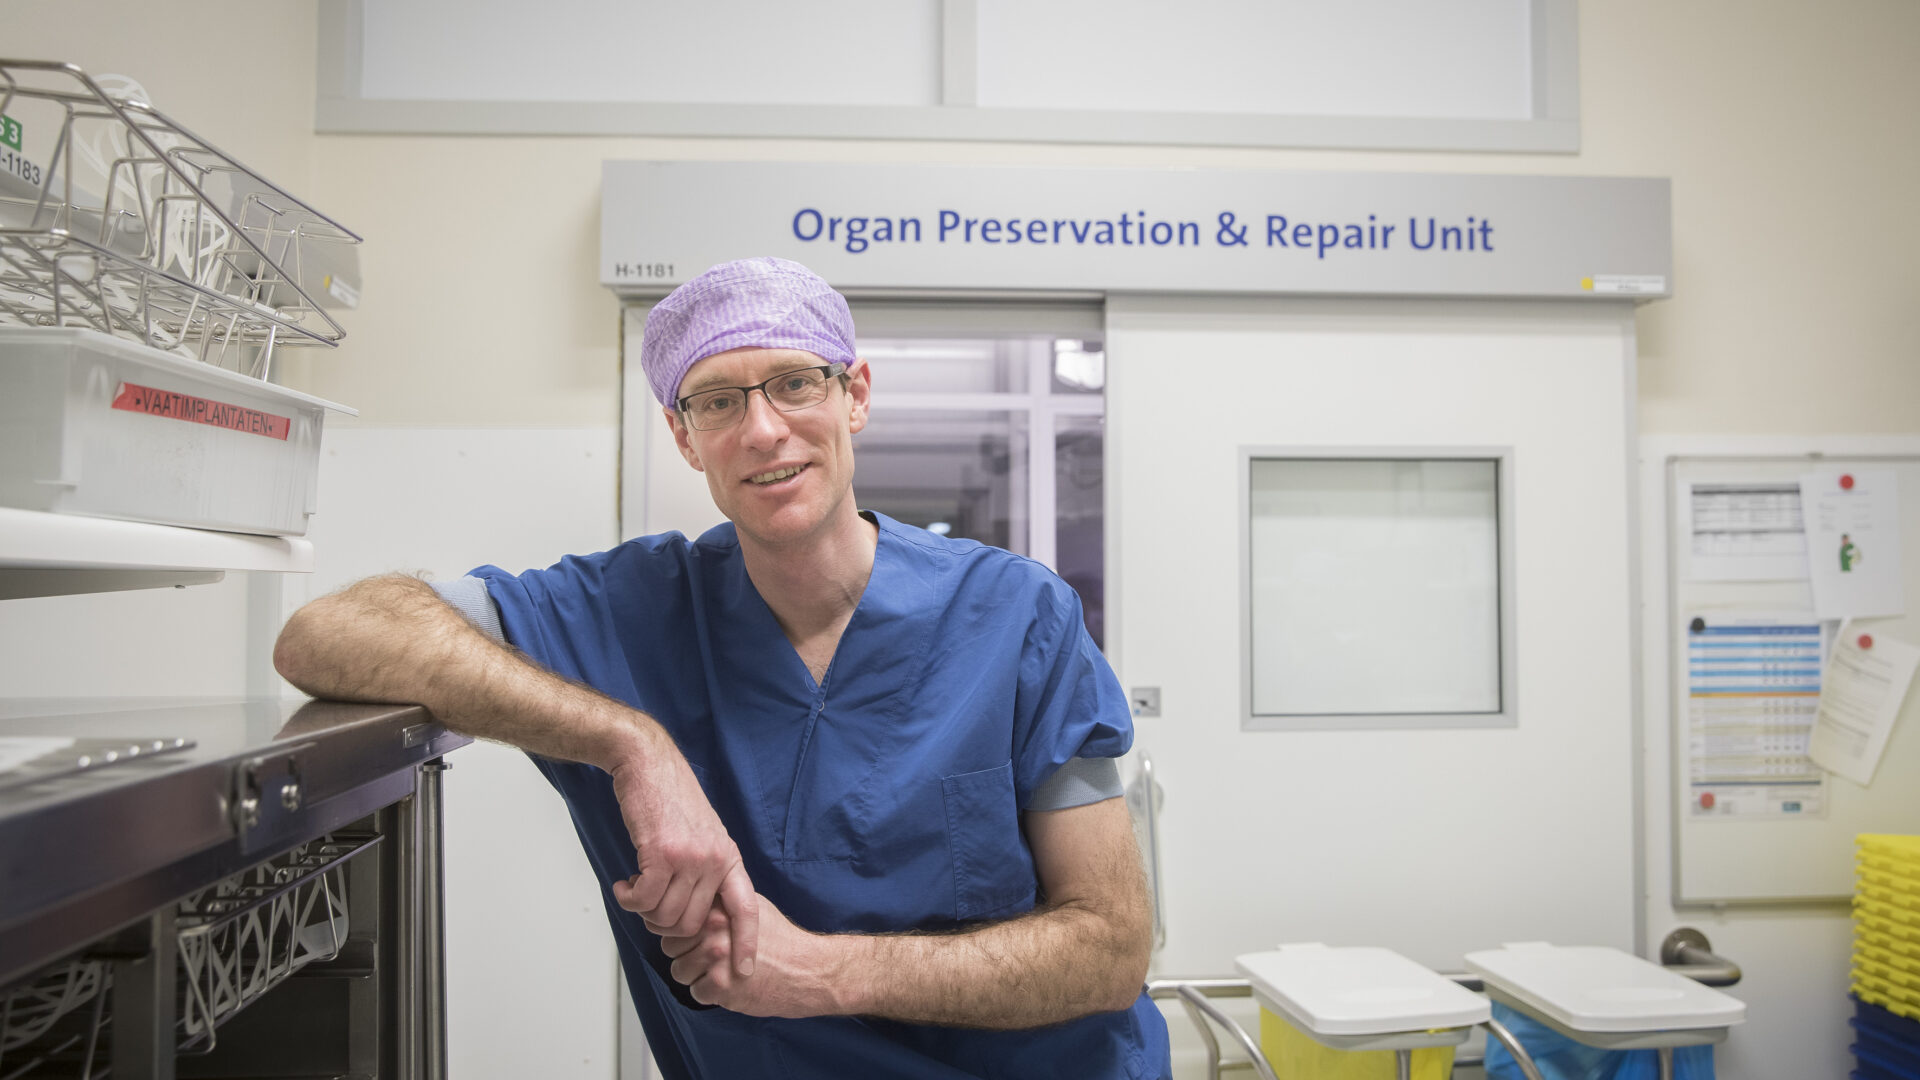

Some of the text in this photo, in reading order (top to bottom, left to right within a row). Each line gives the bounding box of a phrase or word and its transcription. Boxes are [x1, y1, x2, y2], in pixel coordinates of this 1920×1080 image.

[8, 122, 19, 145] 3
[0, 144, 41, 186] -1183
[792, 208, 1494, 259] Organ Preservation & Repair Unit
[615, 262, 674, 278] H-1181
